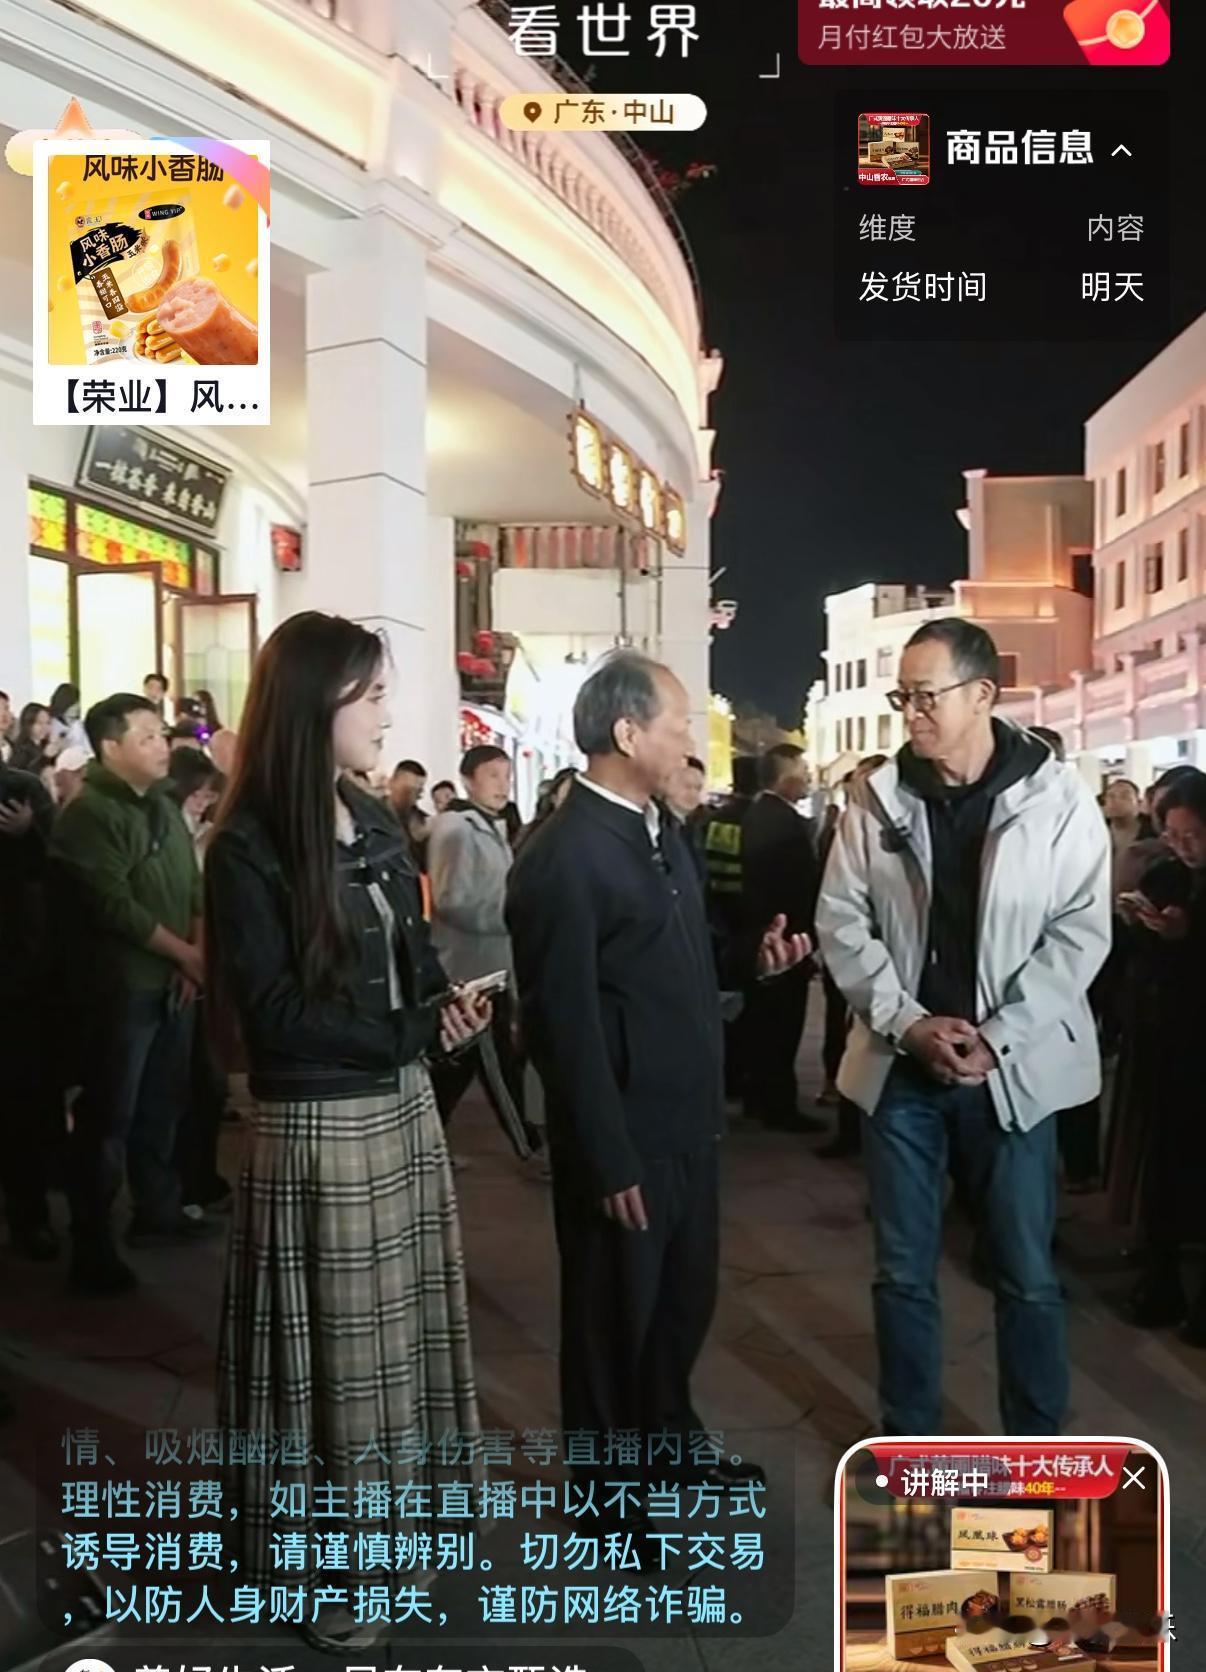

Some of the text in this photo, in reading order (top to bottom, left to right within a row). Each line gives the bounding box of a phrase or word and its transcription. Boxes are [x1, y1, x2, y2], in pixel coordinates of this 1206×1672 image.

[83, 155, 224, 182] 风味小香肠
[151, 208, 169, 217] WING
[80, 228, 109, 253] 风味
[83, 233, 128, 267] 小香肠
